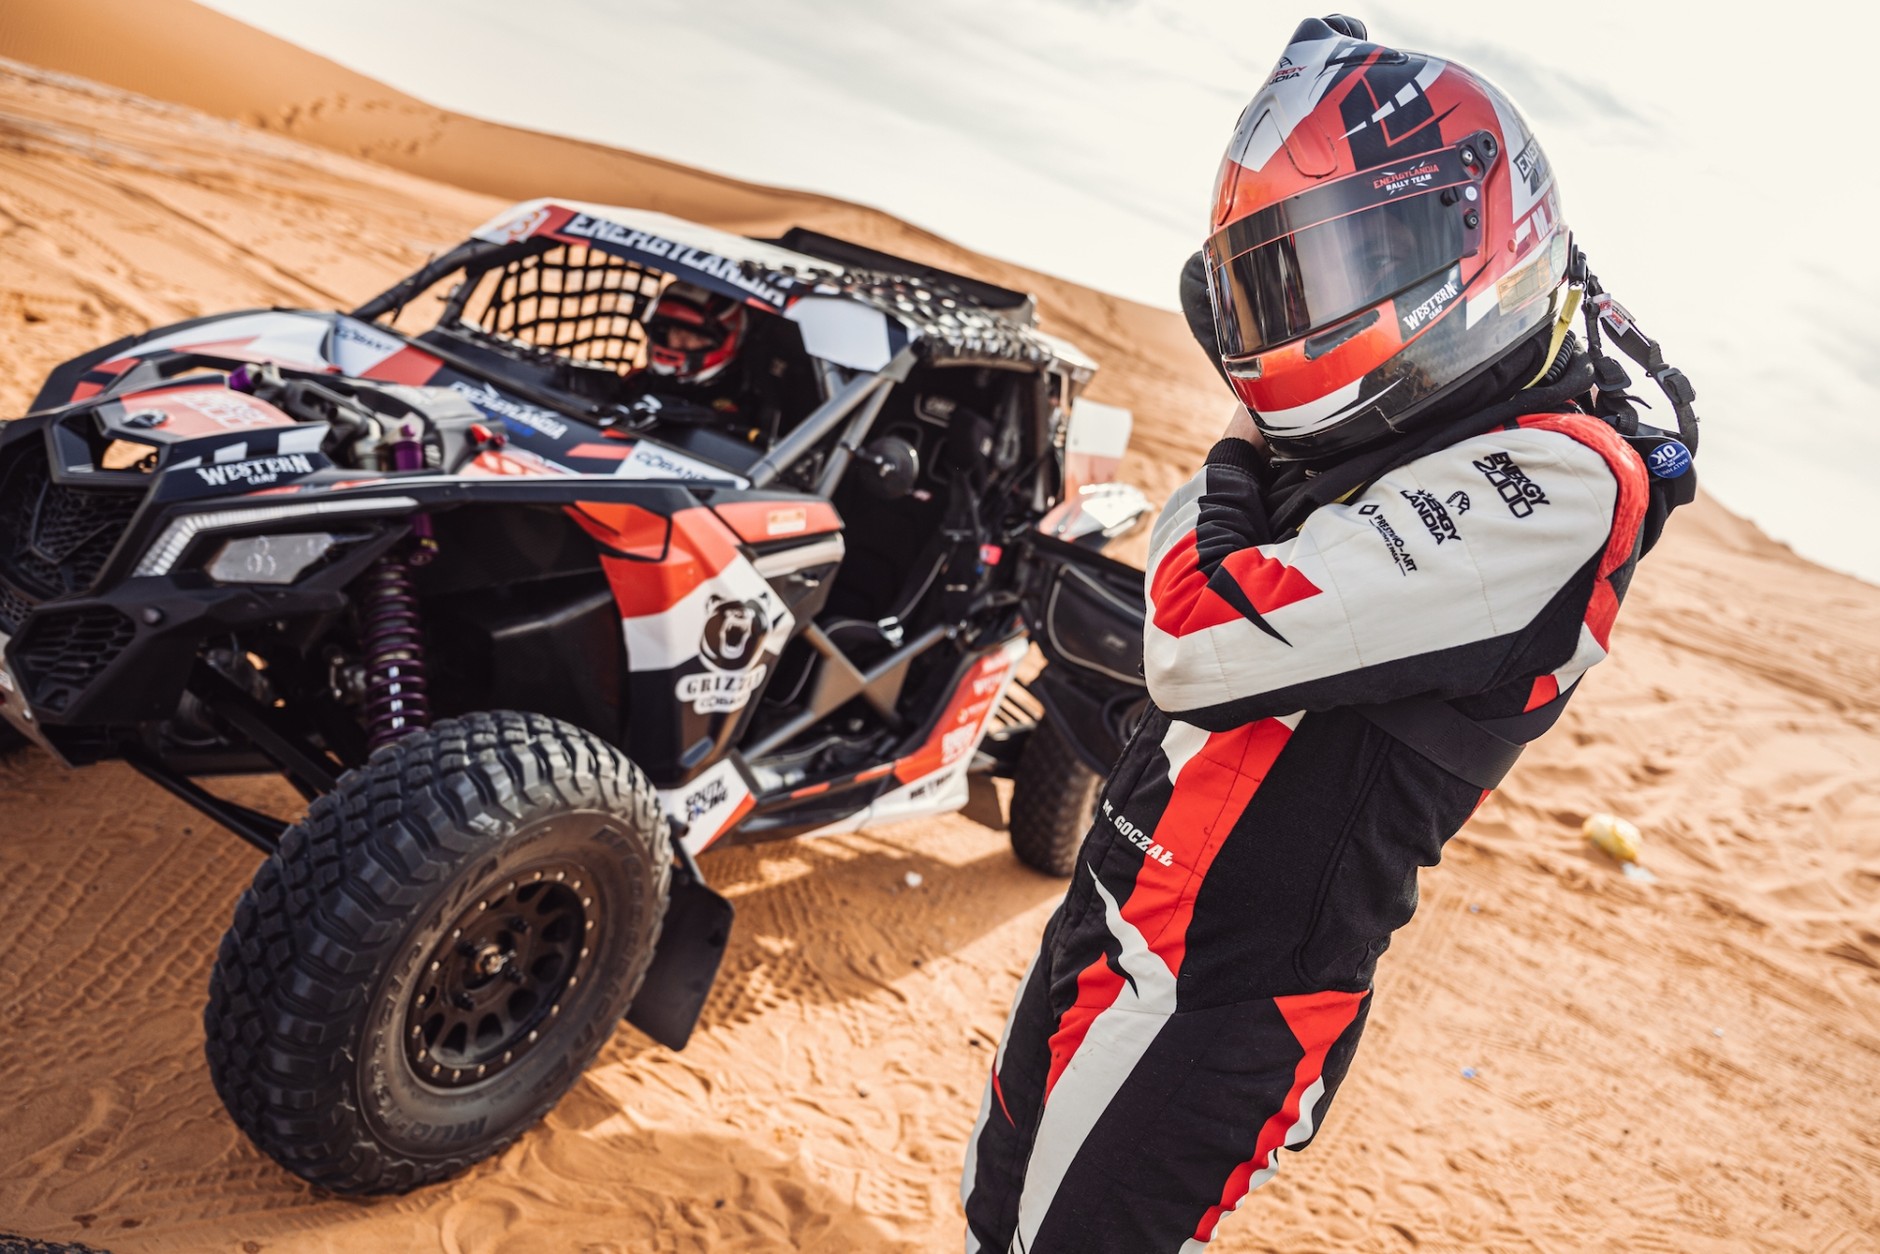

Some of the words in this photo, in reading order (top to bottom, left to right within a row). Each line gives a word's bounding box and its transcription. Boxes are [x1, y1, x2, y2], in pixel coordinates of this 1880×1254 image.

[1373, 164, 1440, 189] ENERGYLANDIA
[1385, 179, 1410, 191] RALLY
[1411, 173, 1432, 184] TEAM
[1402, 280, 1458, 331] WESTERN
[1428, 304, 1443, 320] CAMP
[196, 453, 314, 486] WESTERN
[1650, 444, 1677, 465] OK
[1472, 455, 1534, 519] 2000
[1490, 451, 1551, 505] ENERGY
[1102, 798, 1113, 822] M.
[1113, 815, 1175, 867] GOCZAŁ
